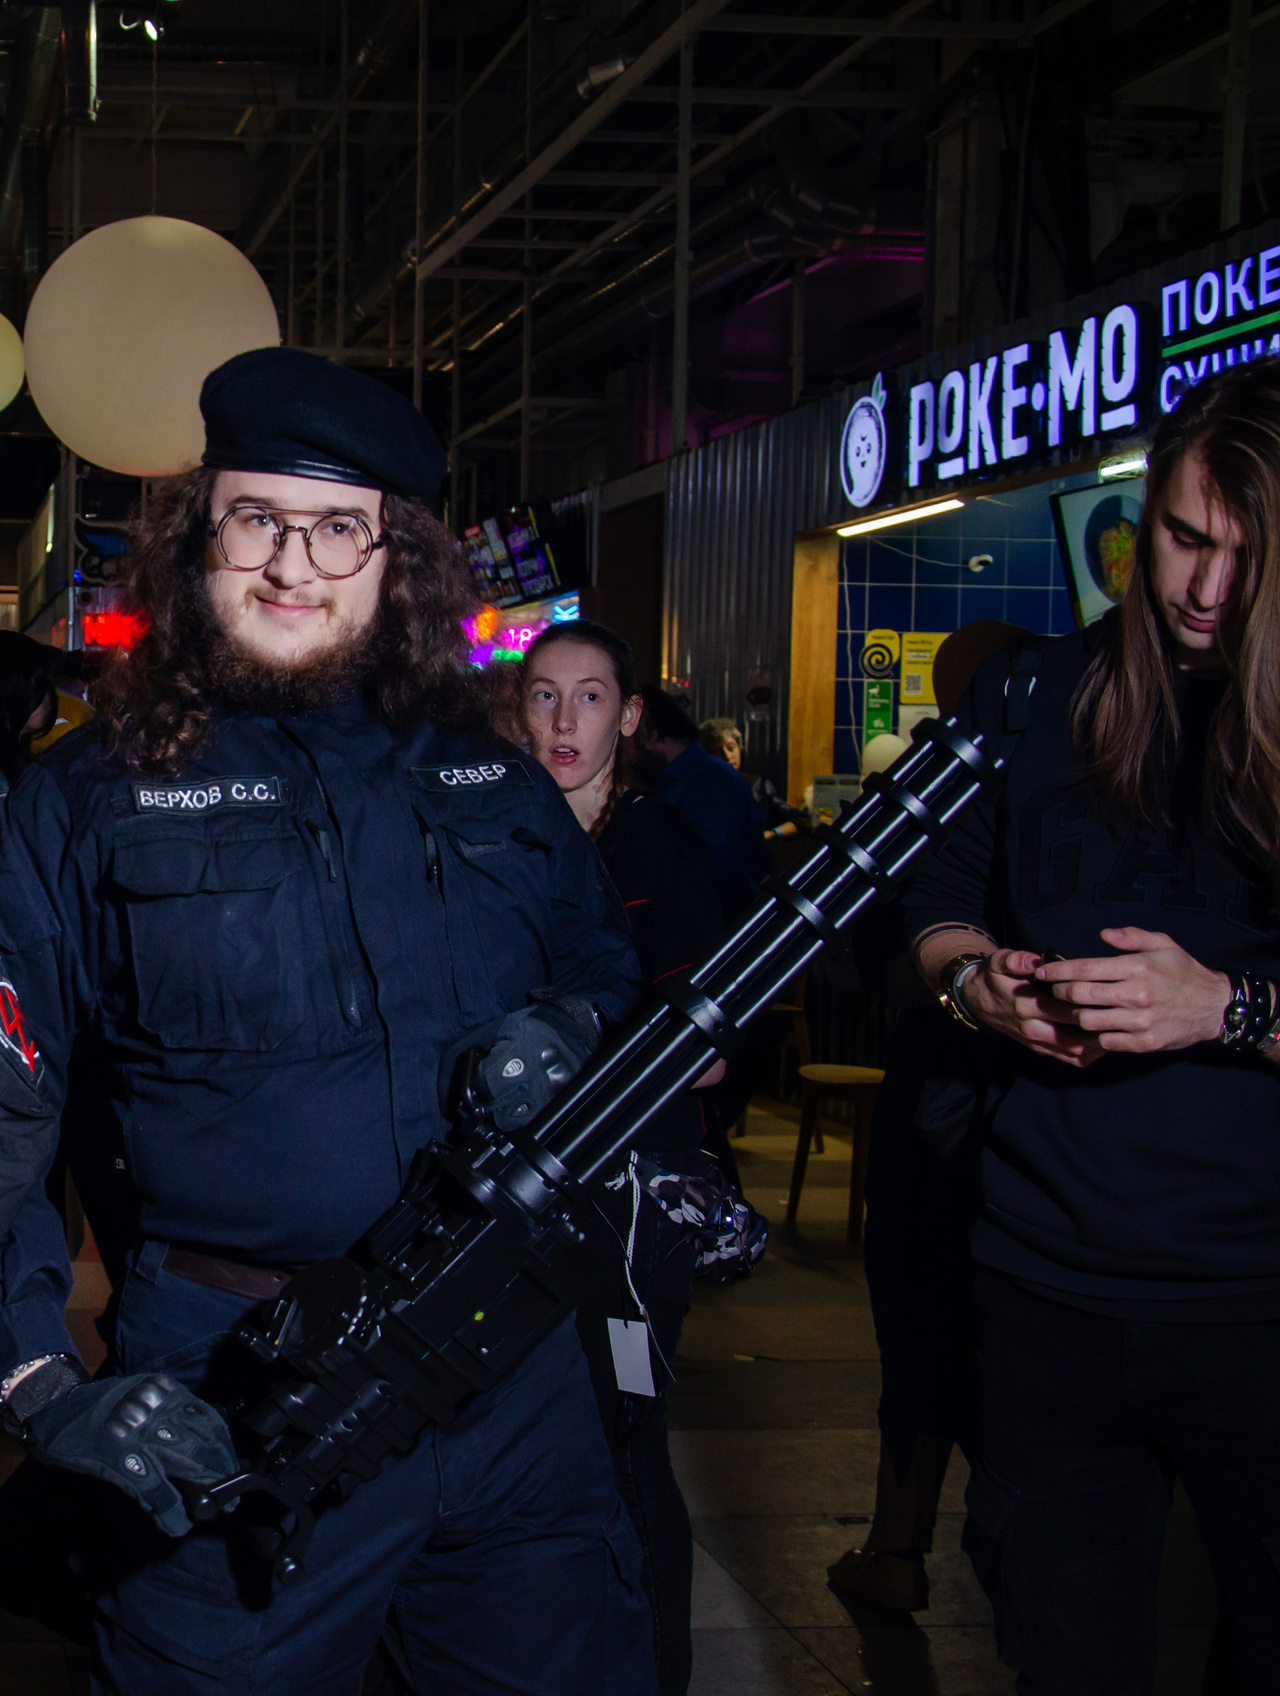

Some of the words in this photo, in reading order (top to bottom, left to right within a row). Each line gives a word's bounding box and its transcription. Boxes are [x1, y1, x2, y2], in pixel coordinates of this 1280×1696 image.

[438, 763, 508, 786] СЕВЕР
[139, 785, 222, 809] ВЕРХОВ
[231, 783, 277, 801] С.С.
